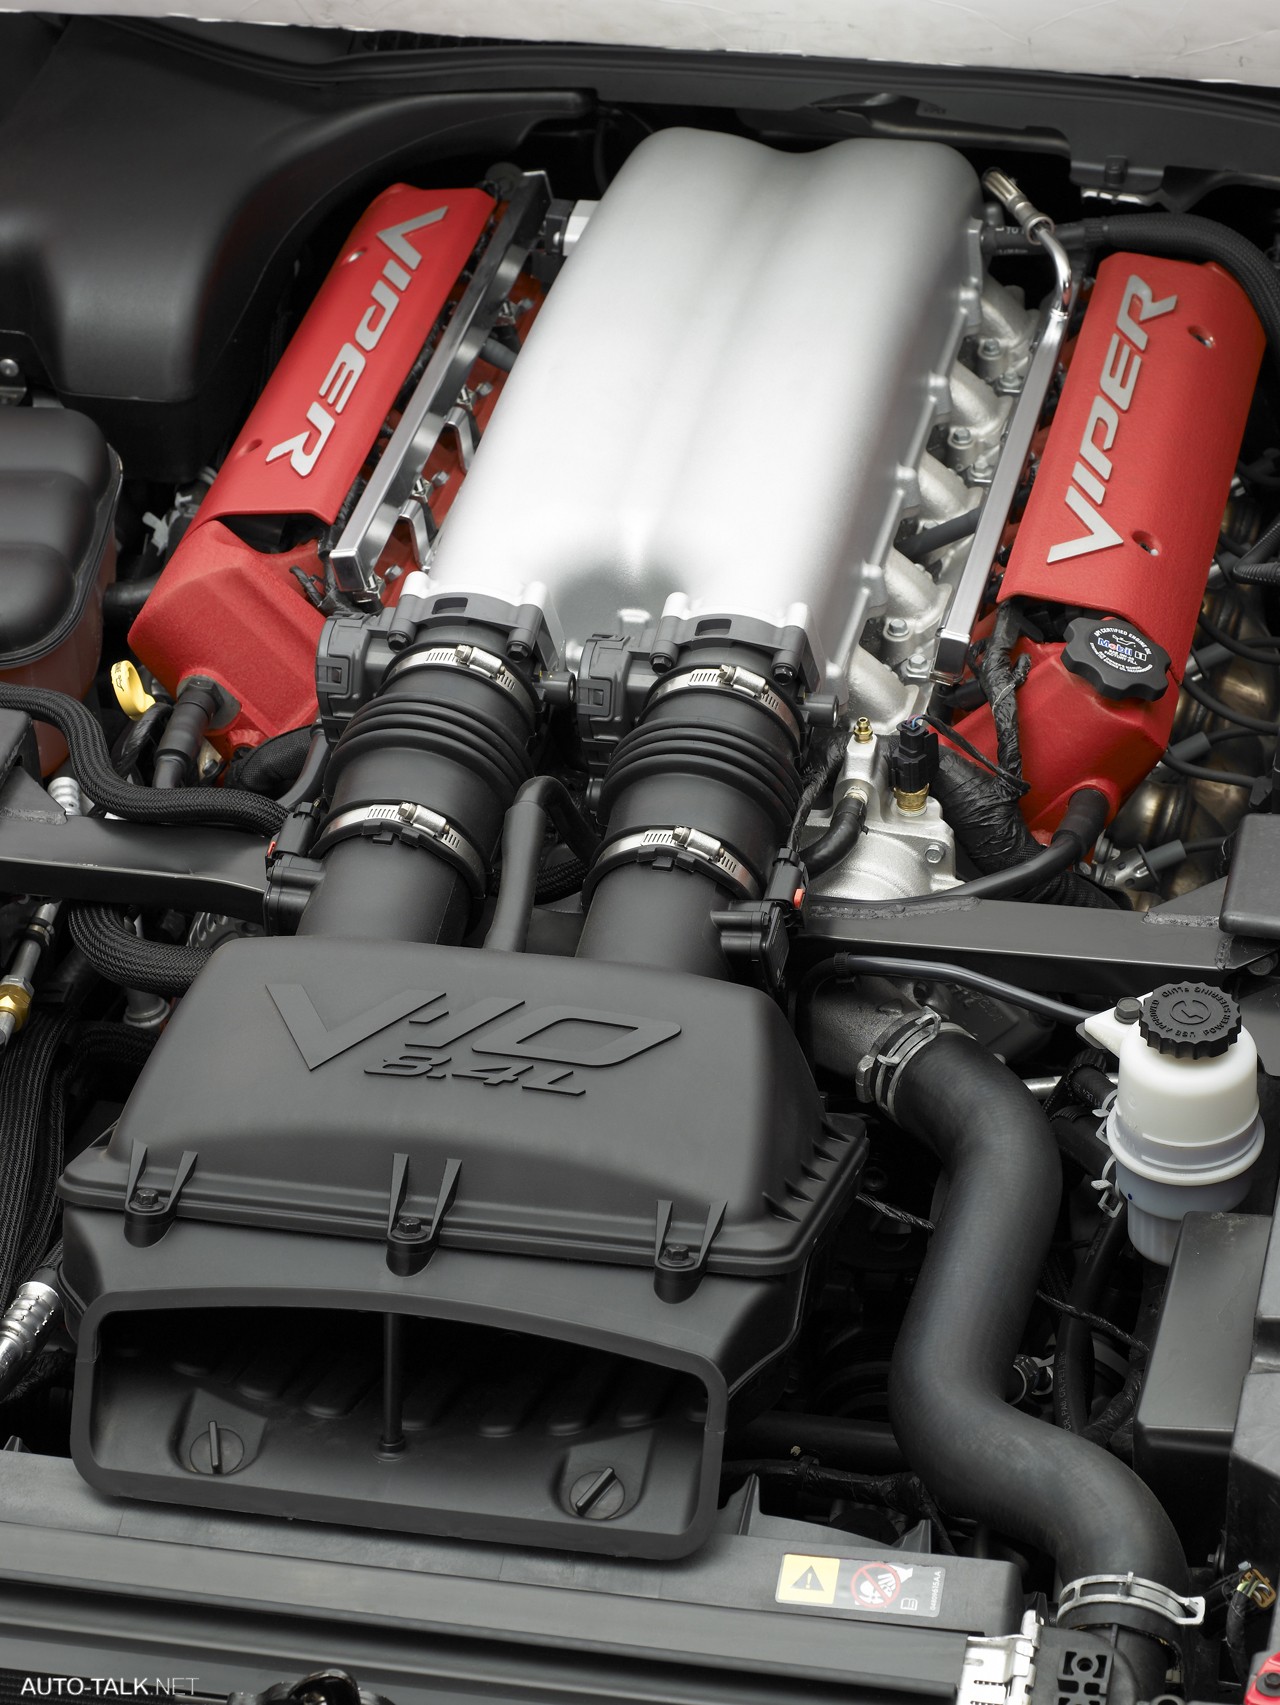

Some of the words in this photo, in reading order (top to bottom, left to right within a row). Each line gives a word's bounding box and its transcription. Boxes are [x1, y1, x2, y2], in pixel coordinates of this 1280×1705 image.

[265, 205, 449, 478] VIPER
[1045, 273, 1179, 565] VIPER
[1097, 637, 1133, 656] Mobil
[1194, 986, 1231, 1014] STEERING
[1203, 1014, 1231, 1036] POWER
[363, 1053, 587, 1097] 8.4L
